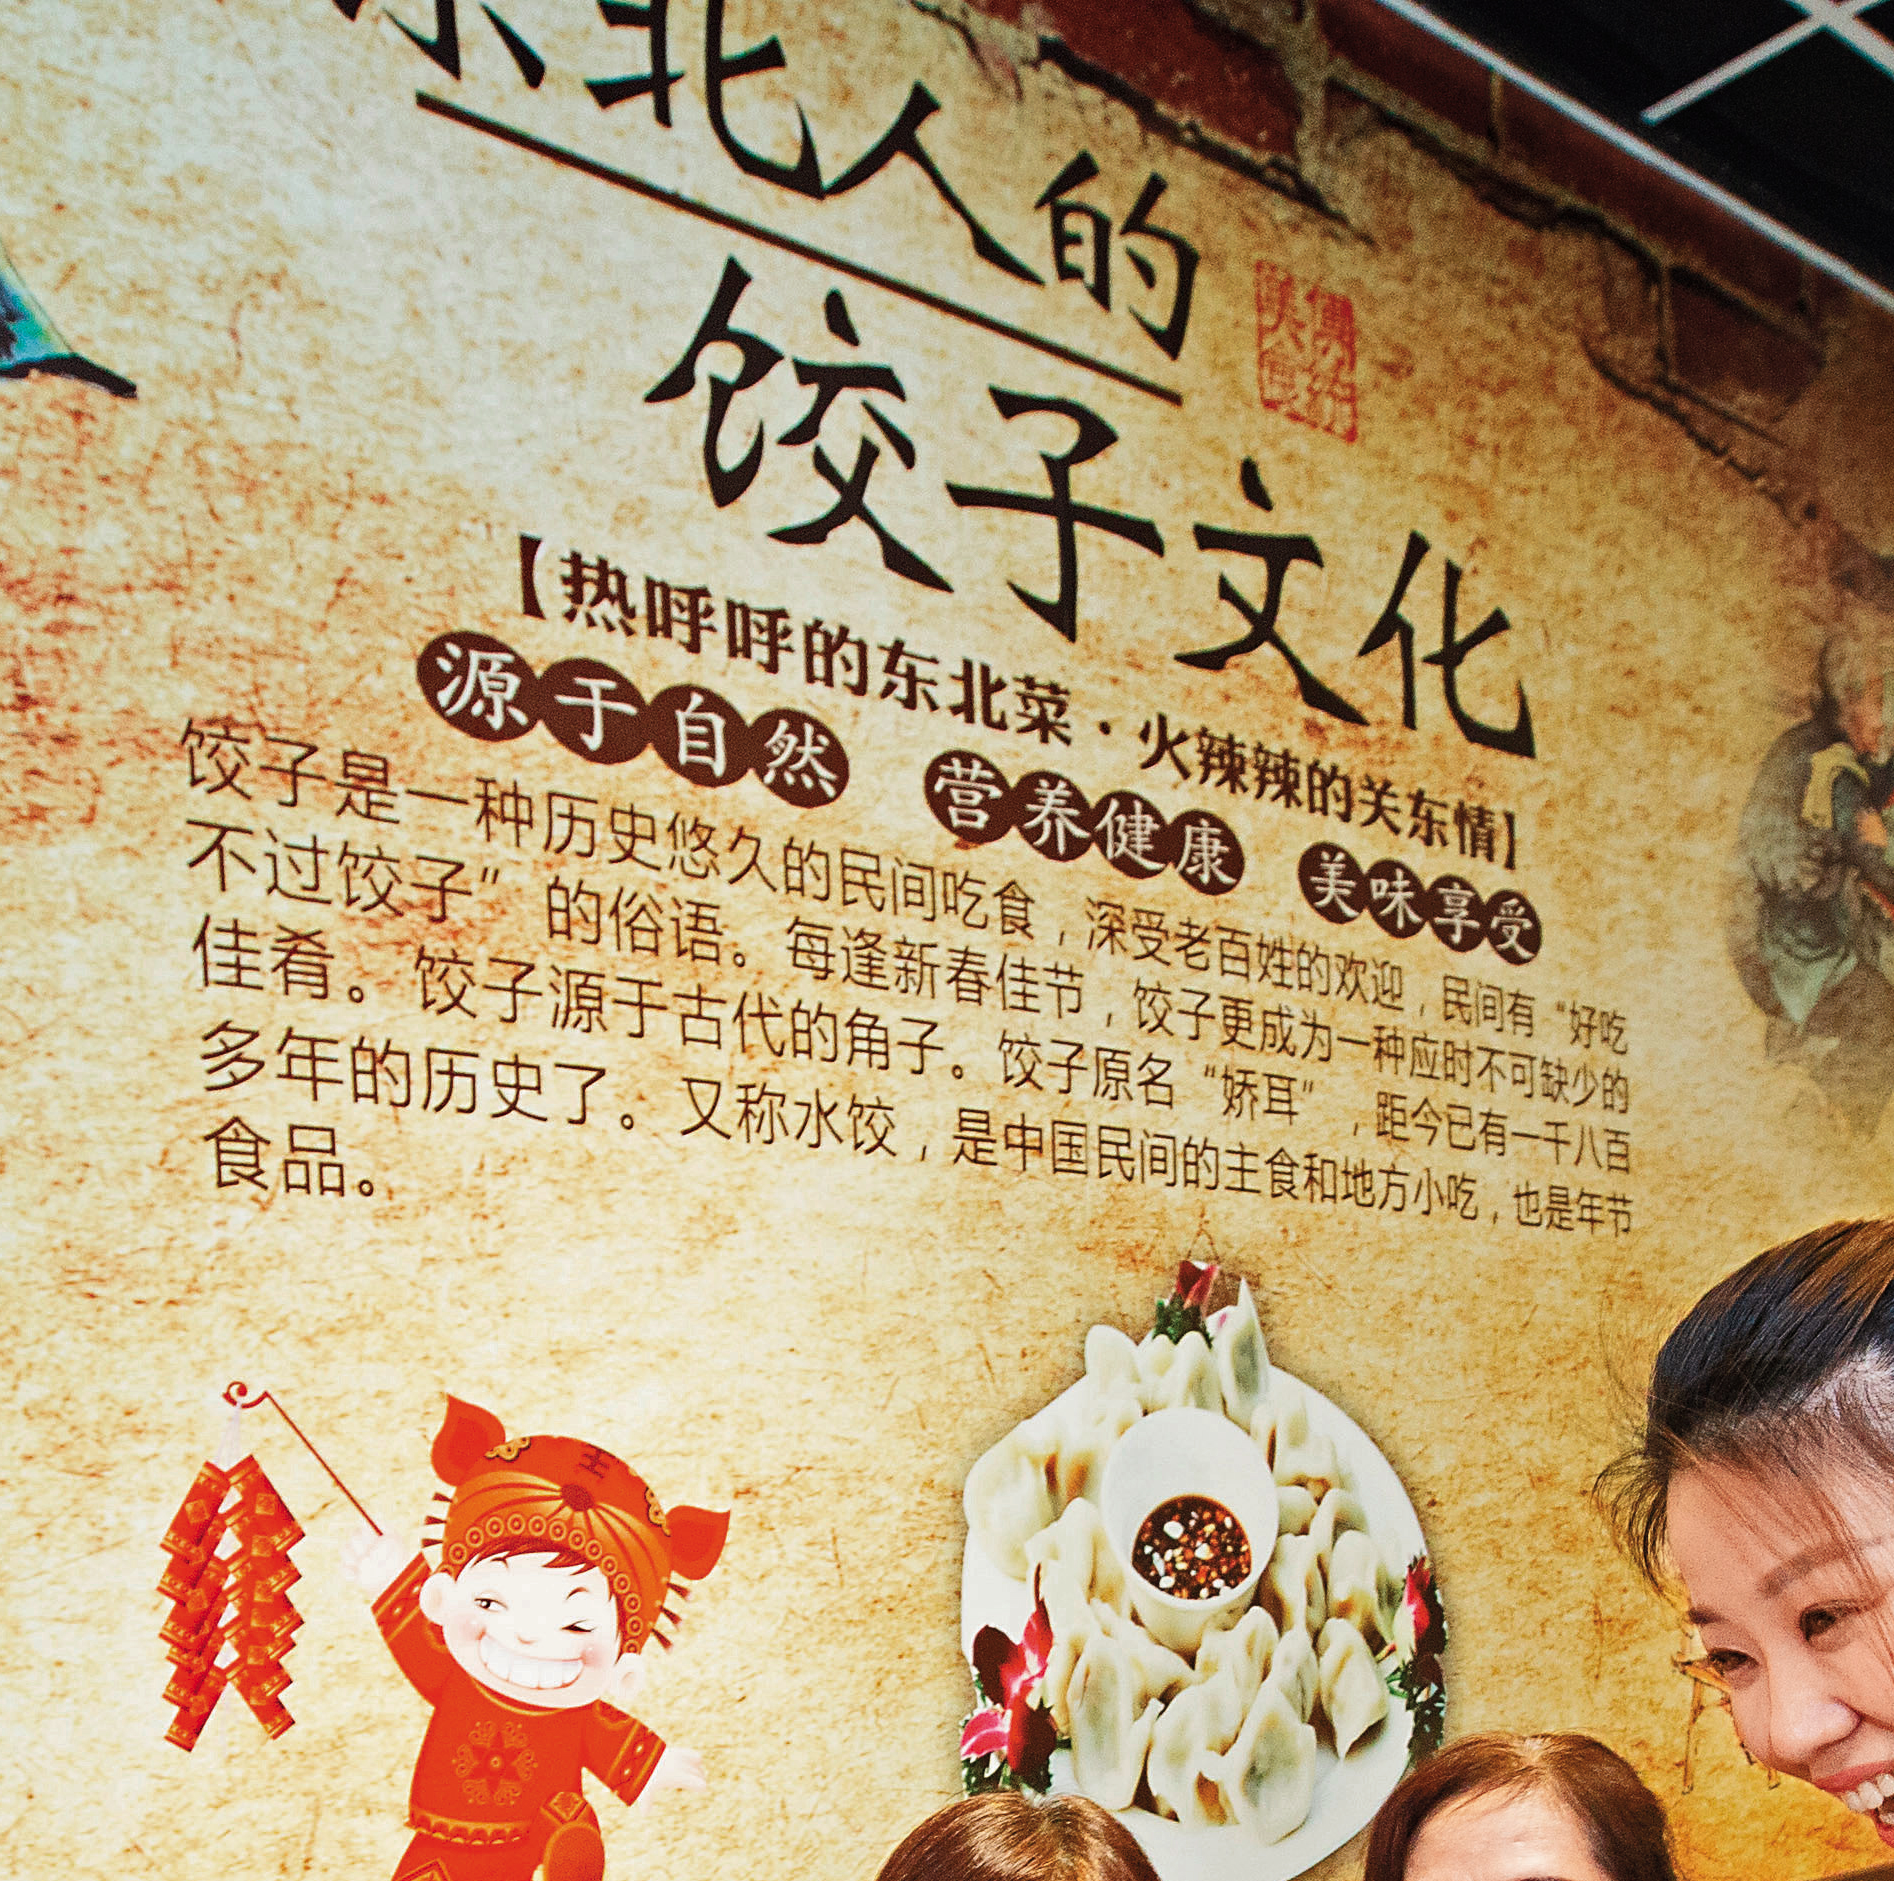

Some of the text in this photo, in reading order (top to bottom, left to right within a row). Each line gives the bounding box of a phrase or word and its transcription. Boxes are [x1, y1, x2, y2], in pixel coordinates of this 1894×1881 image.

[644, 256, 1537, 760] 饺子文化
[435, 640, 1539, 964] 源于自然 营养健康 美味享受
[203, 1114, 376, 1199] 食品。
